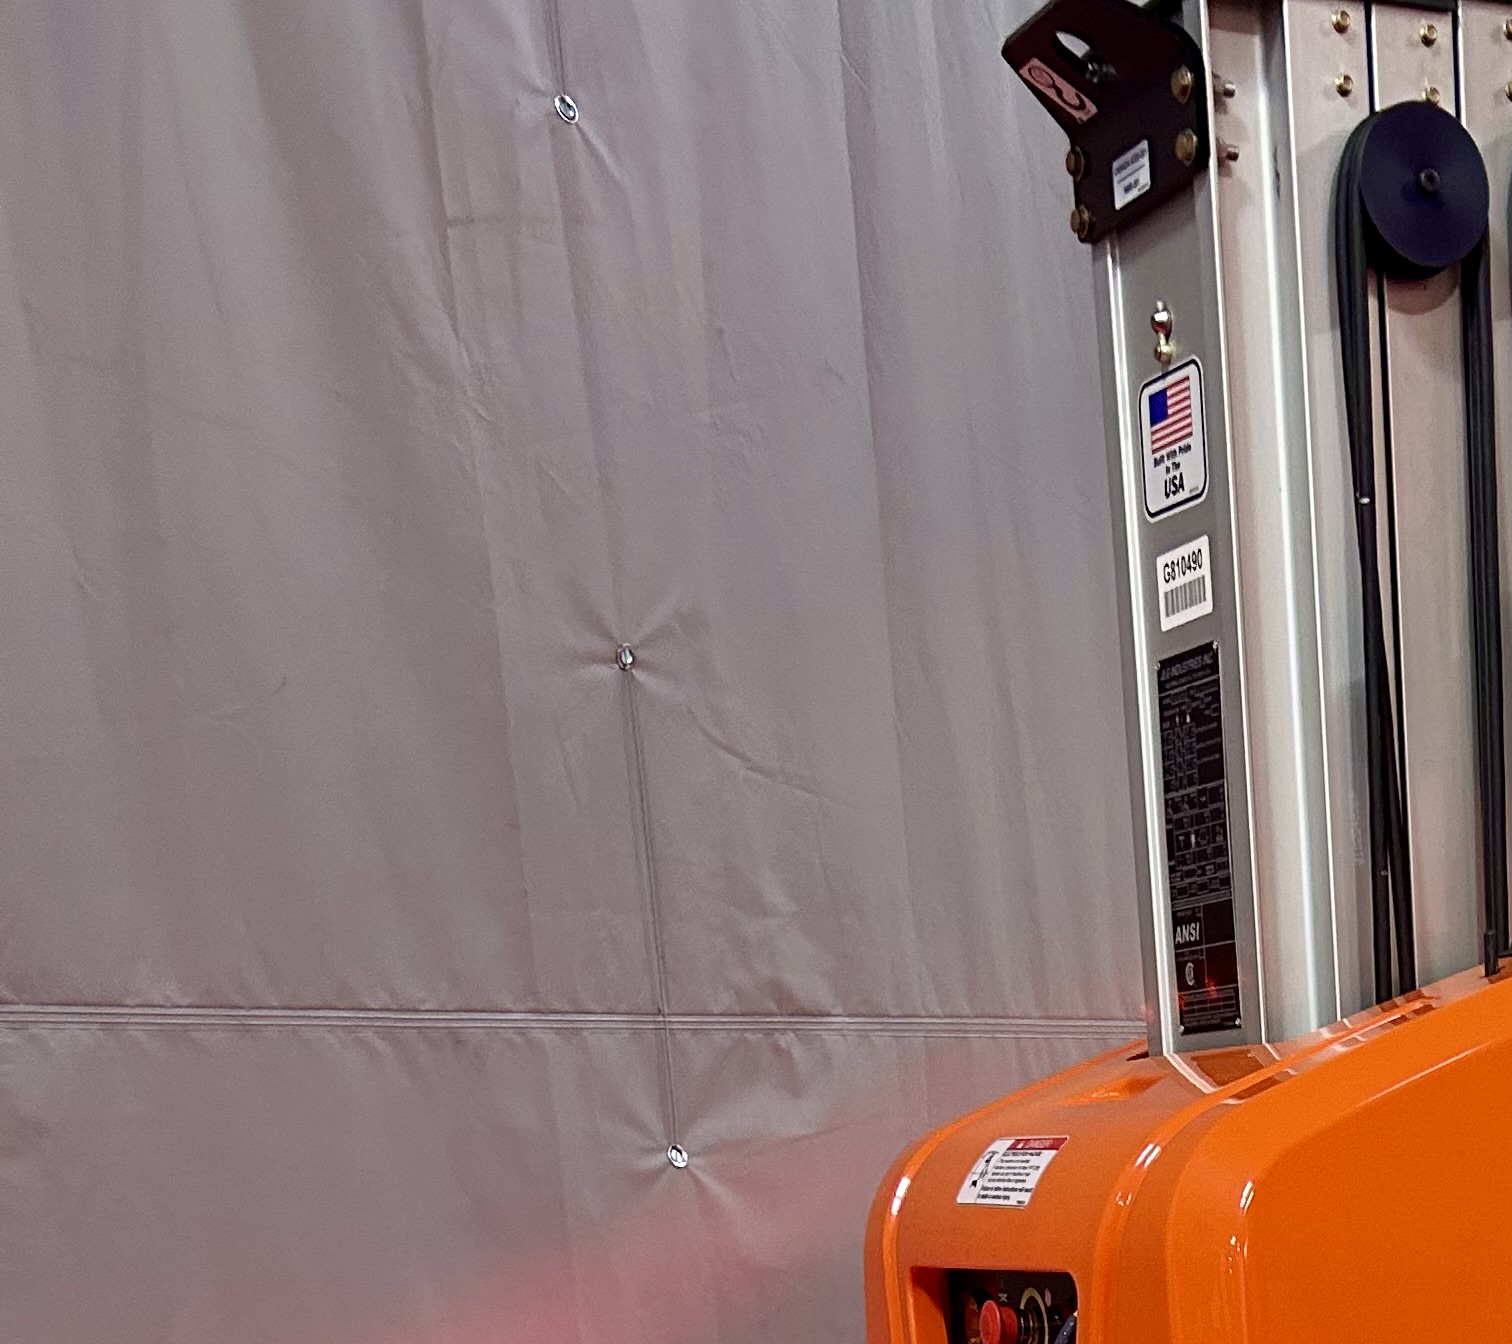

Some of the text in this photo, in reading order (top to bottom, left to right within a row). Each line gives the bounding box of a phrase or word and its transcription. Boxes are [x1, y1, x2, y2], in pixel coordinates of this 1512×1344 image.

[1164, 471, 1185, 499] USA
[1163, 548, 1203, 584] G810490
[1175, 921, 1200, 945] ANSI
